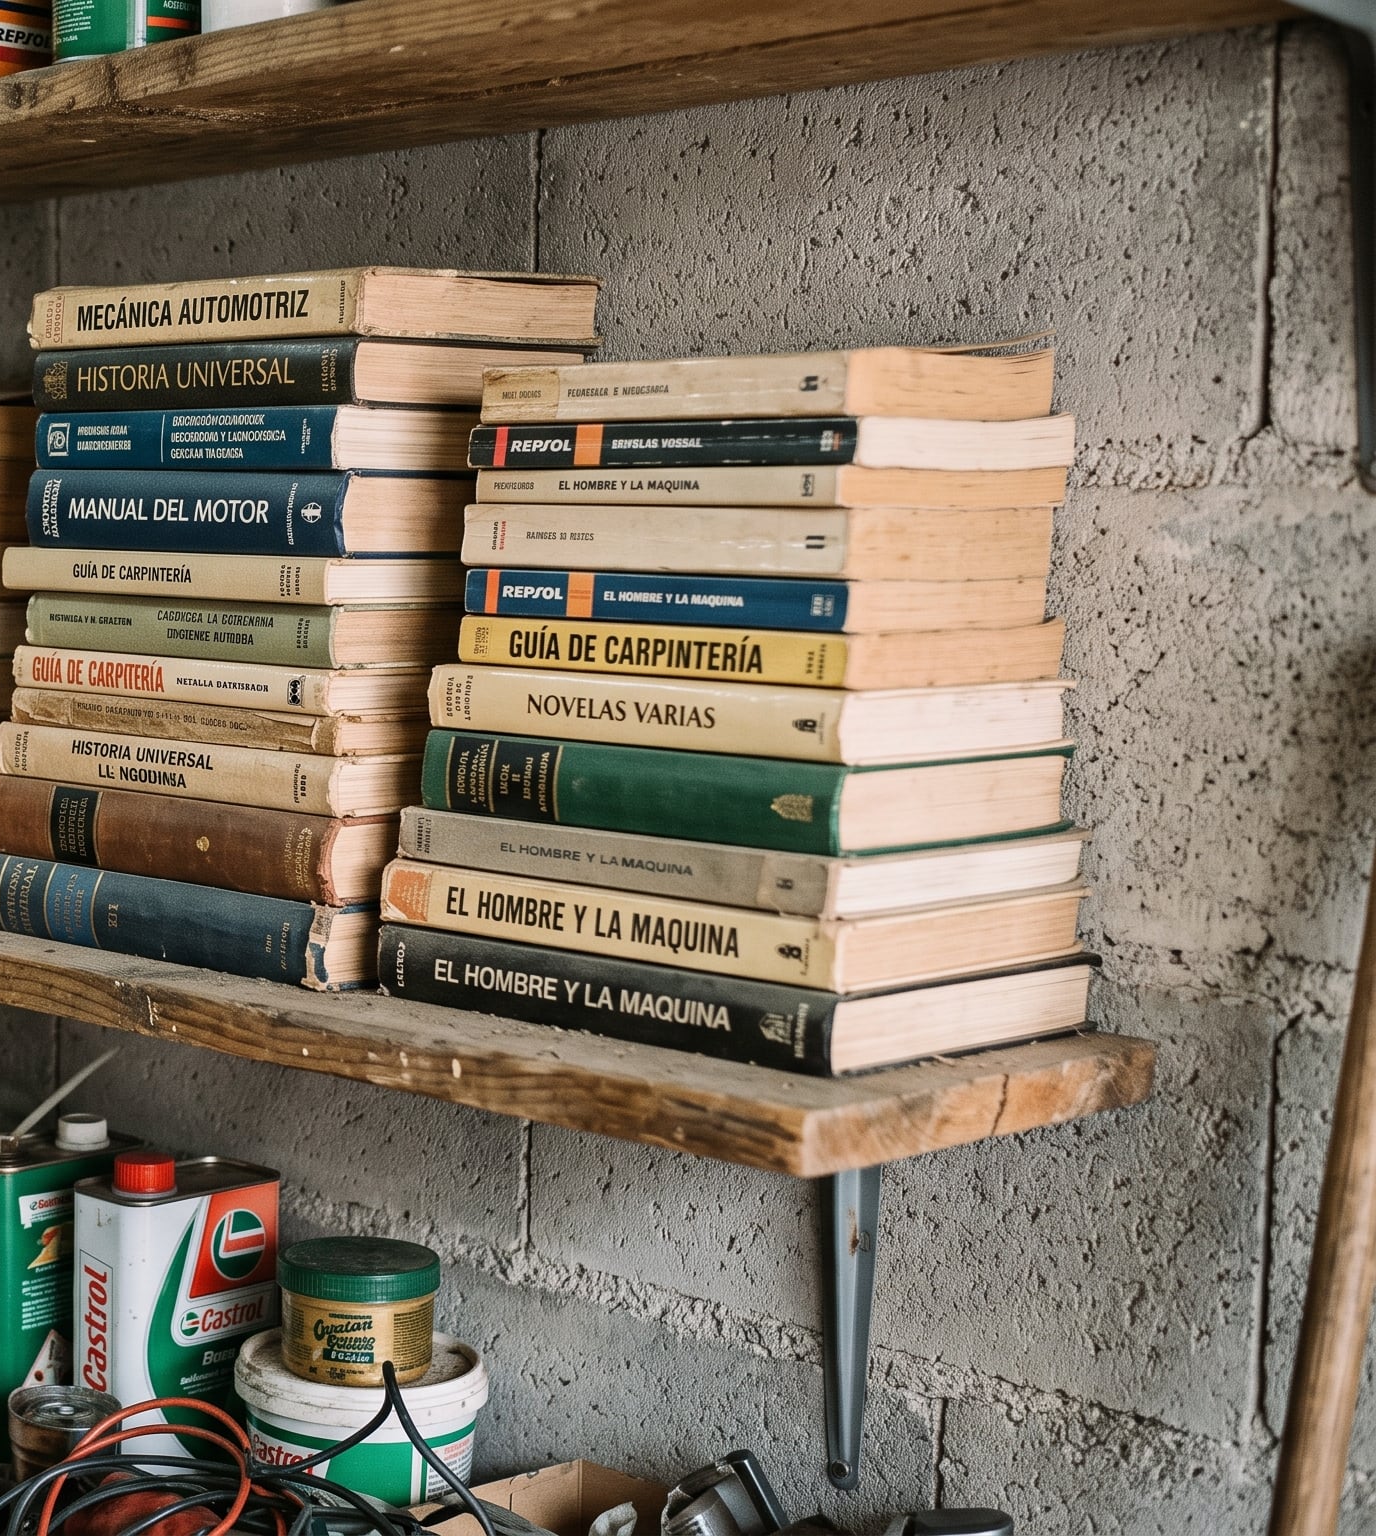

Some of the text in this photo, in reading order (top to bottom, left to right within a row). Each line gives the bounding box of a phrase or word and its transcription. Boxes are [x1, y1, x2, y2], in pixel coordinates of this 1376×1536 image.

[77, 296, 172, 332] MECÁNICA
[178, 289, 309, 328] AUTOMOTRIZ
[77, 365, 169, 392] HISTORIA
[176, 357, 295, 388] UNIVERSAL
[510, 439, 572, 453] REPSOL
[558, 480, 700, 493] EL HOMBRE Y LA MAQUINA
[68, 498, 269, 524] MANUAL DEL MOTOR
[73, 561, 192, 584] GUÍA DE CARPINTERÍA
[502, 585, 744, 608] REPSOL EL HOMBRE Y LA MAQUINA
[509, 625, 763, 674] GUÍA DE CARPINTERÍA
[32, 652, 62, 684] GUÍA
[67, 658, 84, 686] DE
[527, 694, 716, 729] NOVELAS VARIAS
[71, 740, 214, 770] HISTORIA UNIVERSAL
[500, 842, 694, 877] EL HOMBRE Y LA MAQUINA
[446, 886, 739, 958] EL HOMBRE Y LA MAQUINA
[434, 959, 459, 985] EL
[464, 964, 558, 1001] HOMBRE
[563, 979, 580, 1003] Y
[584, 983, 613, 1010] LA
[619, 988, 732, 1032] MAQUINA
[83, 1264, 108, 1393] Castrol
[201, 1296, 264, 1332] Castrol
